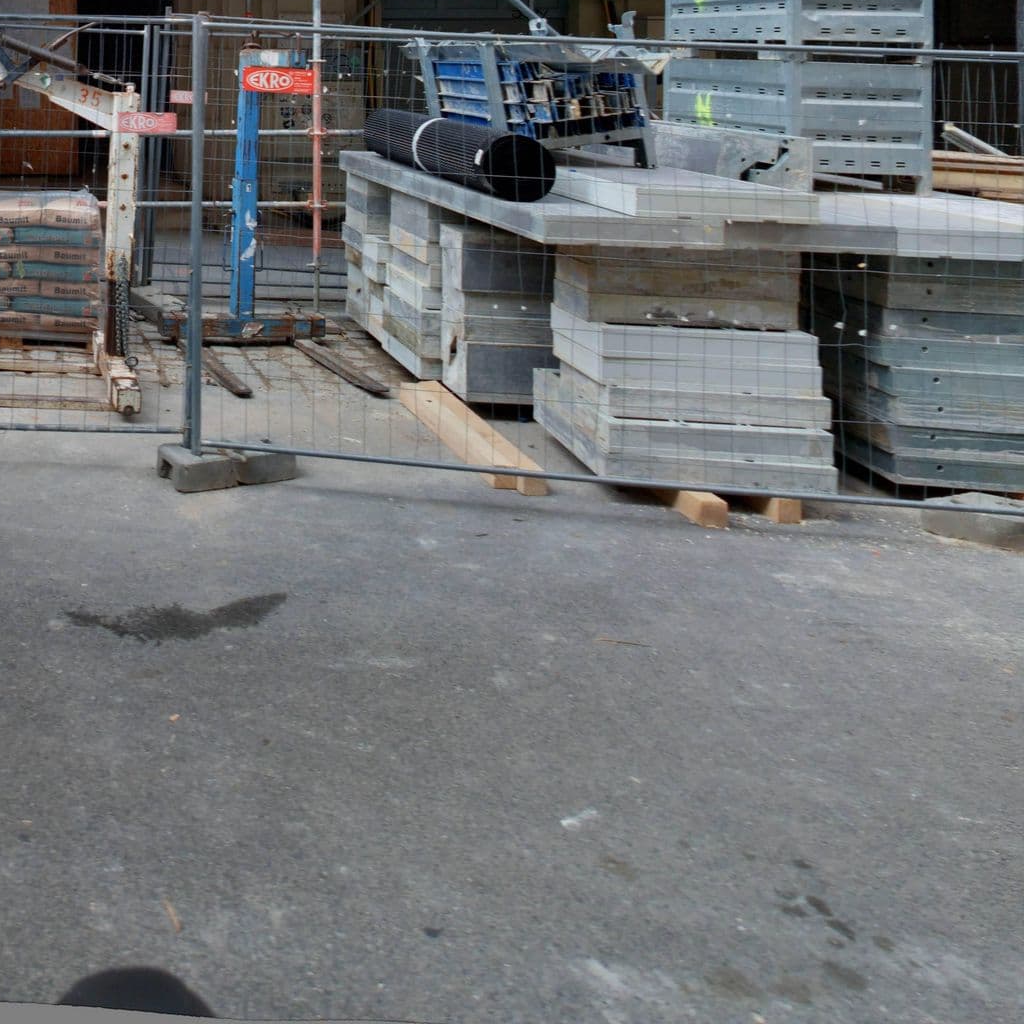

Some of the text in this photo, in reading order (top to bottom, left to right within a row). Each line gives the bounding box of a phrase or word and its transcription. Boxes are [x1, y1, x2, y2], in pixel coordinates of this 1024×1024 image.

[248, 72, 291, 89] EKRO
[78, 87, 102, 109] 35
[121, 115, 155, 129] EKRO
